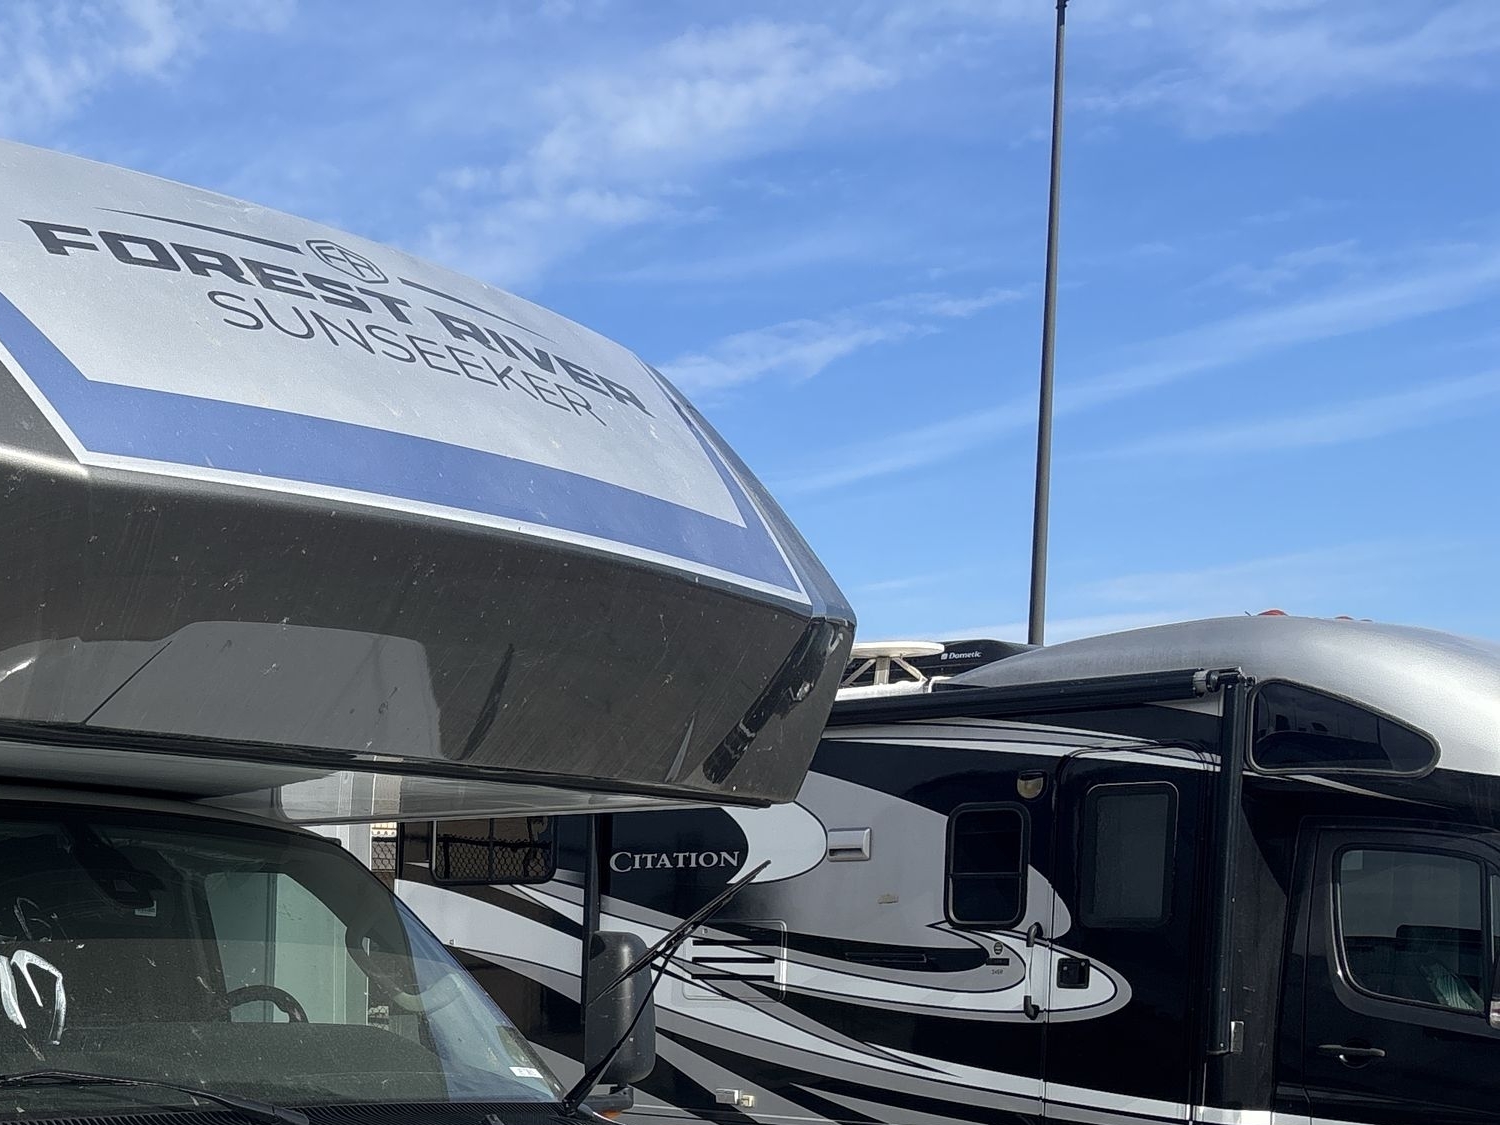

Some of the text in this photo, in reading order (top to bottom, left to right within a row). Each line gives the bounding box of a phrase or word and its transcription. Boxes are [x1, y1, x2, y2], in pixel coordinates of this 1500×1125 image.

[18, 219, 657, 419] FOREST RIVER
[207, 291, 607, 427] SUNSEEKER
[949, 651, 982, 660] Dometic
[609, 851, 740, 873] CITATION
